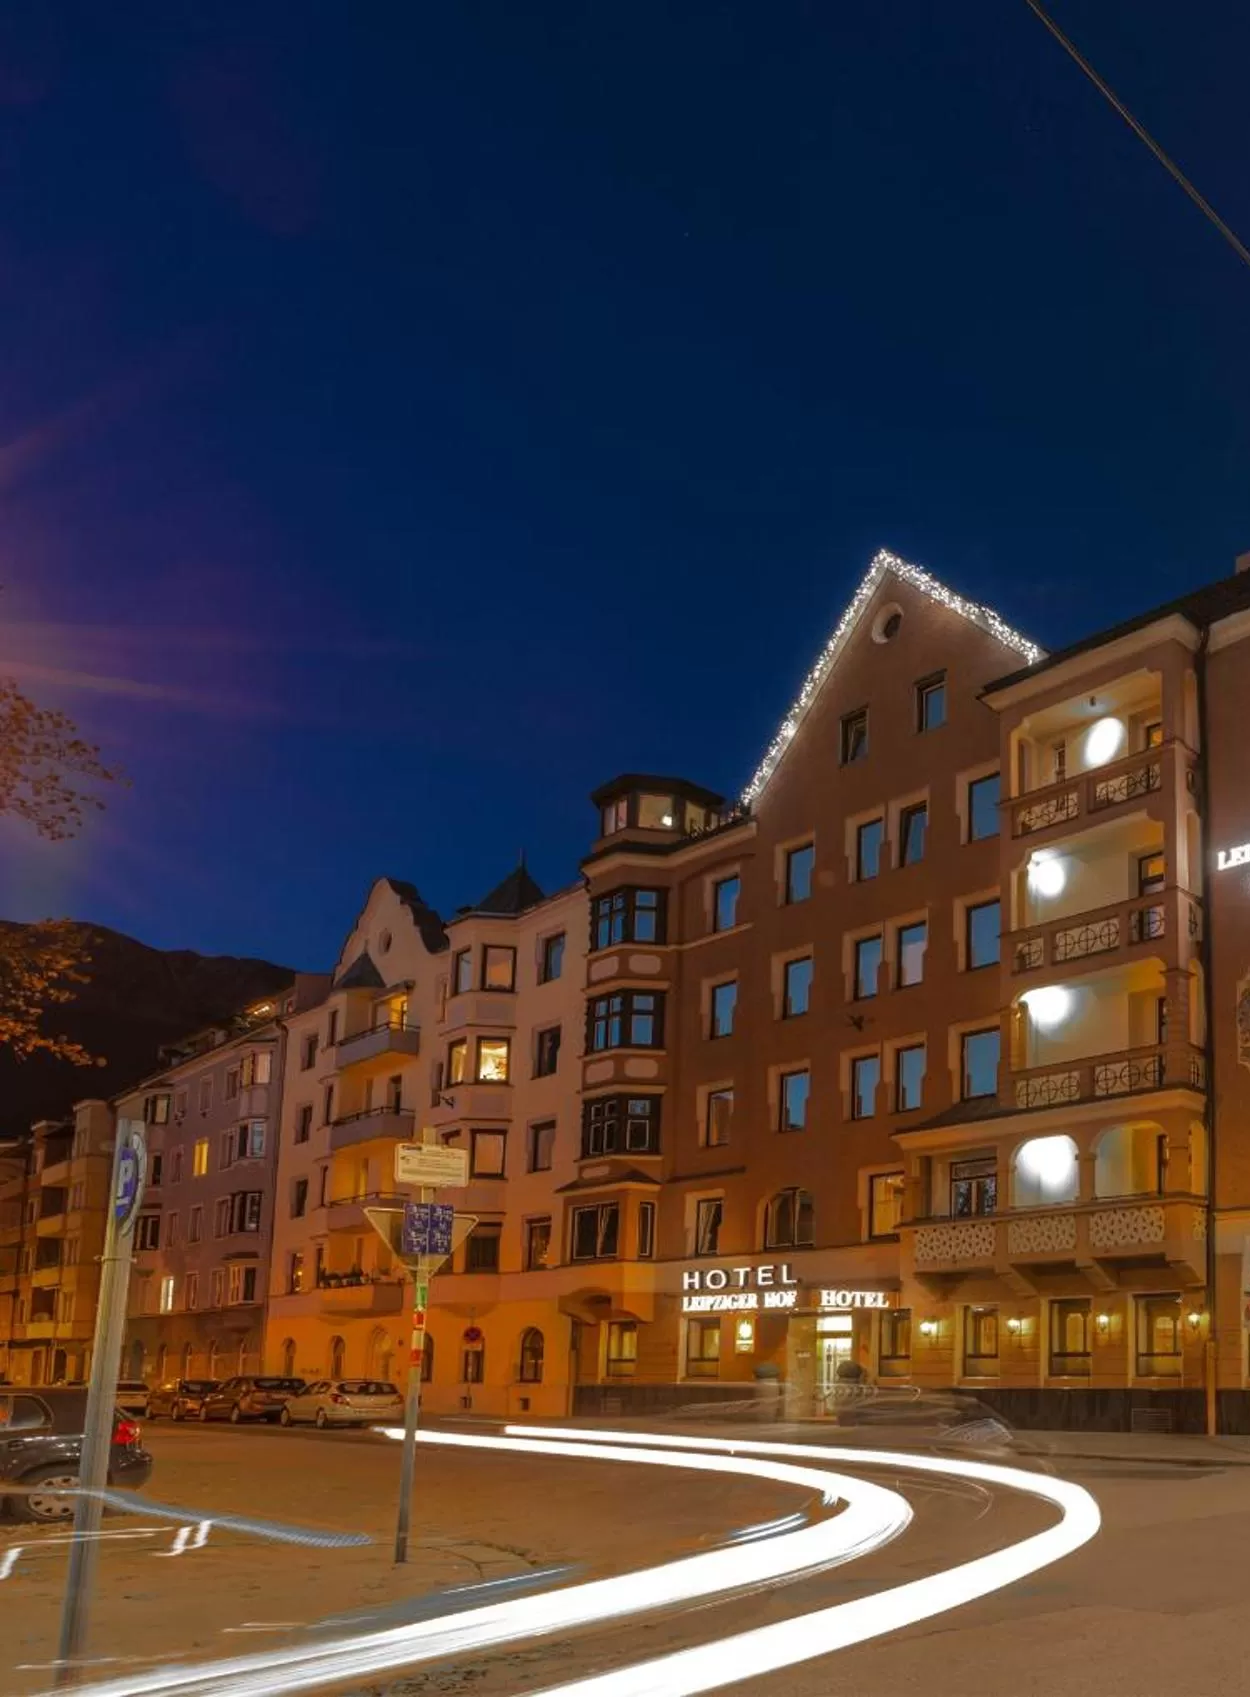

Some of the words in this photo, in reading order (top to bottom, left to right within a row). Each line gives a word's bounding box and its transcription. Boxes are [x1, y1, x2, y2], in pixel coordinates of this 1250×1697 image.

[683, 1264, 798, 1290] HOTEL
[682, 1293, 758, 1312] LEIPZIGER
[764, 1290, 798, 1308] HOF
[819, 1289, 890, 1308] HOTEL
